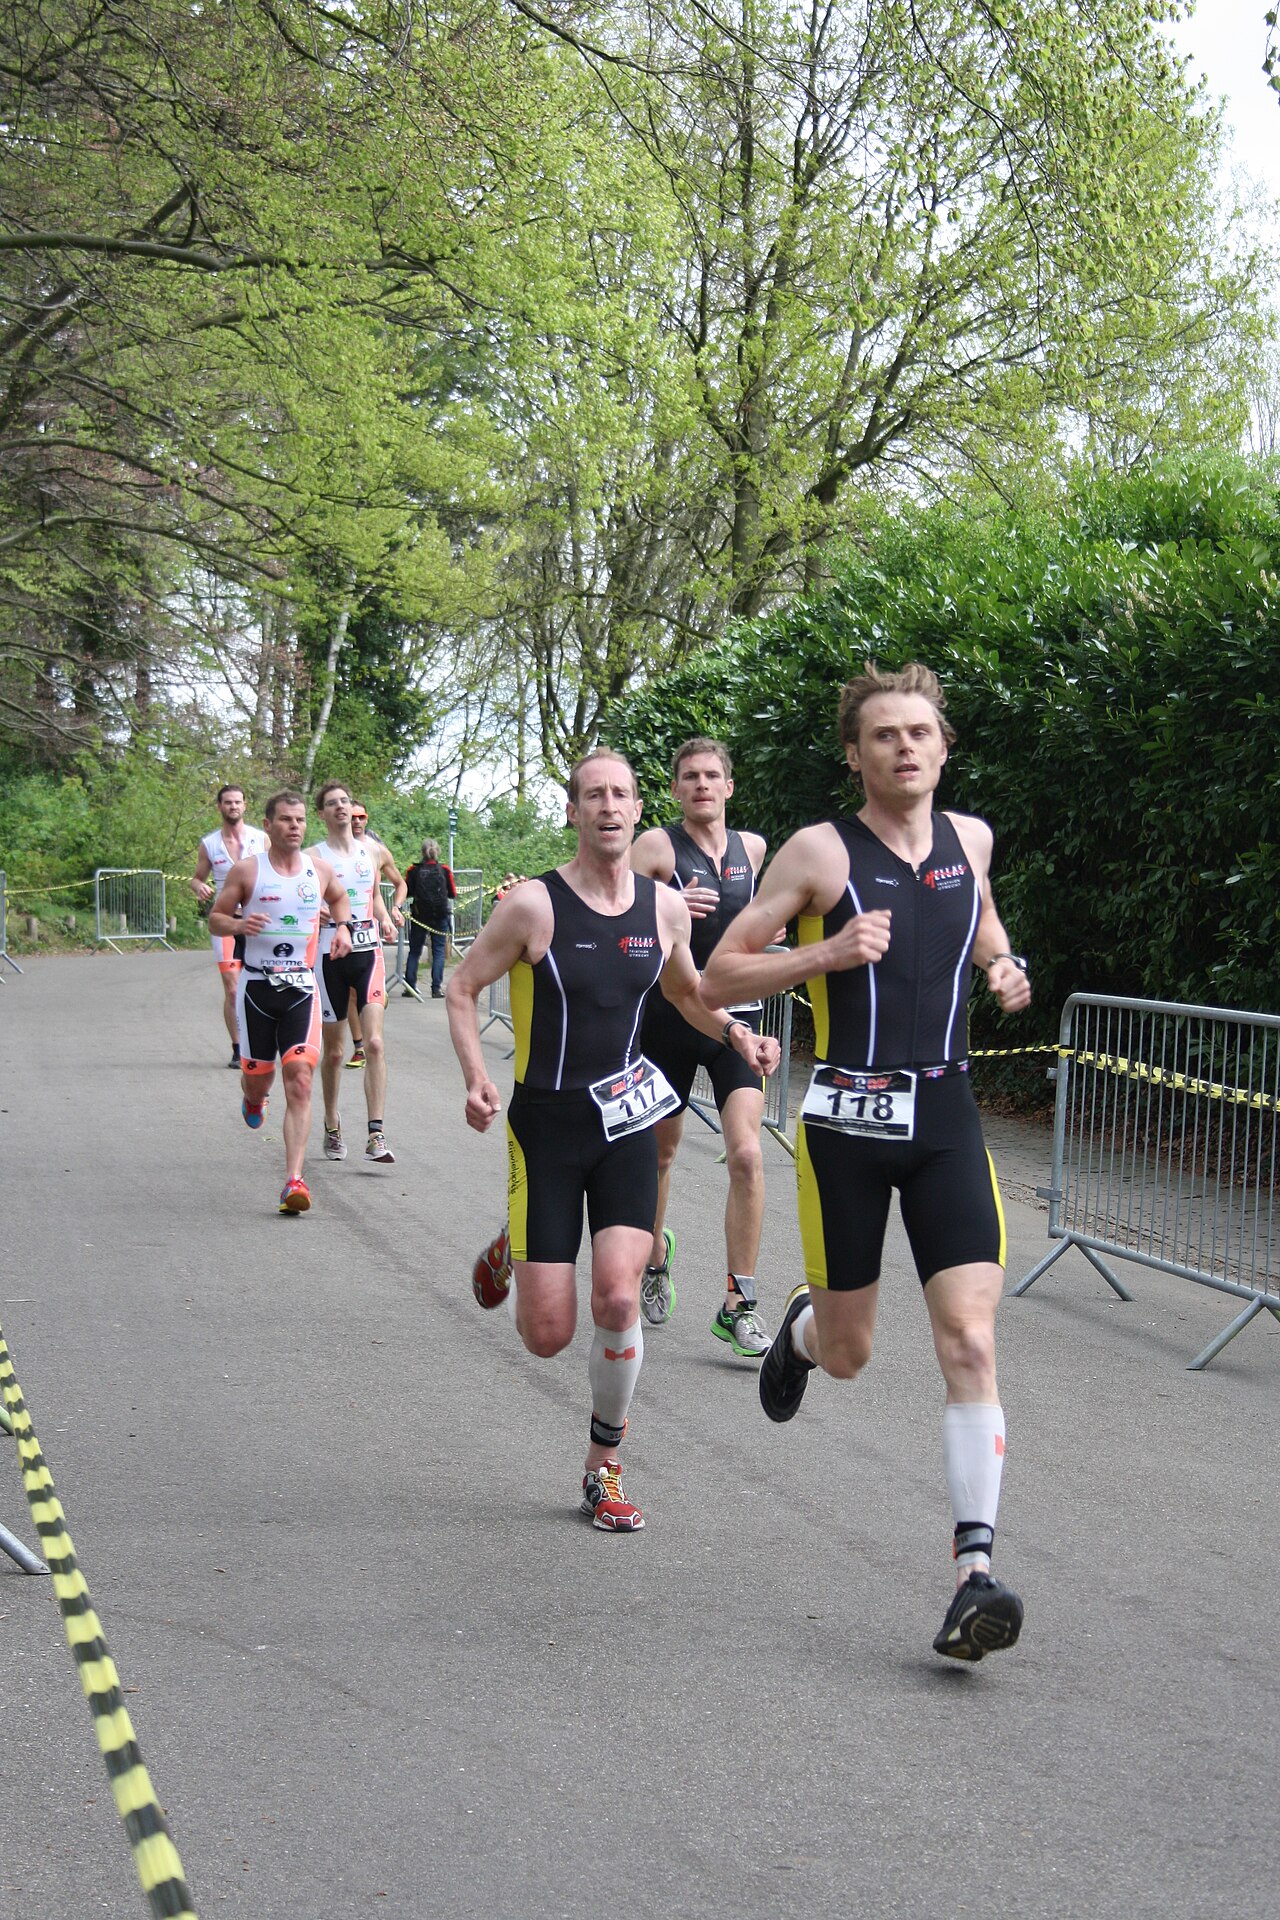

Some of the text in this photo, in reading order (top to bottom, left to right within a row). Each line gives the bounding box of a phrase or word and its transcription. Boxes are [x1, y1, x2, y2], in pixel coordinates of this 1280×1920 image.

[923, 864, 967, 889] HELLAS
[618, 936, 656, 955] HELLAS
[260, 959, 303, 967] innerme
[619, 1078, 657, 1118] 117
[827, 1091, 894, 1121] 118
